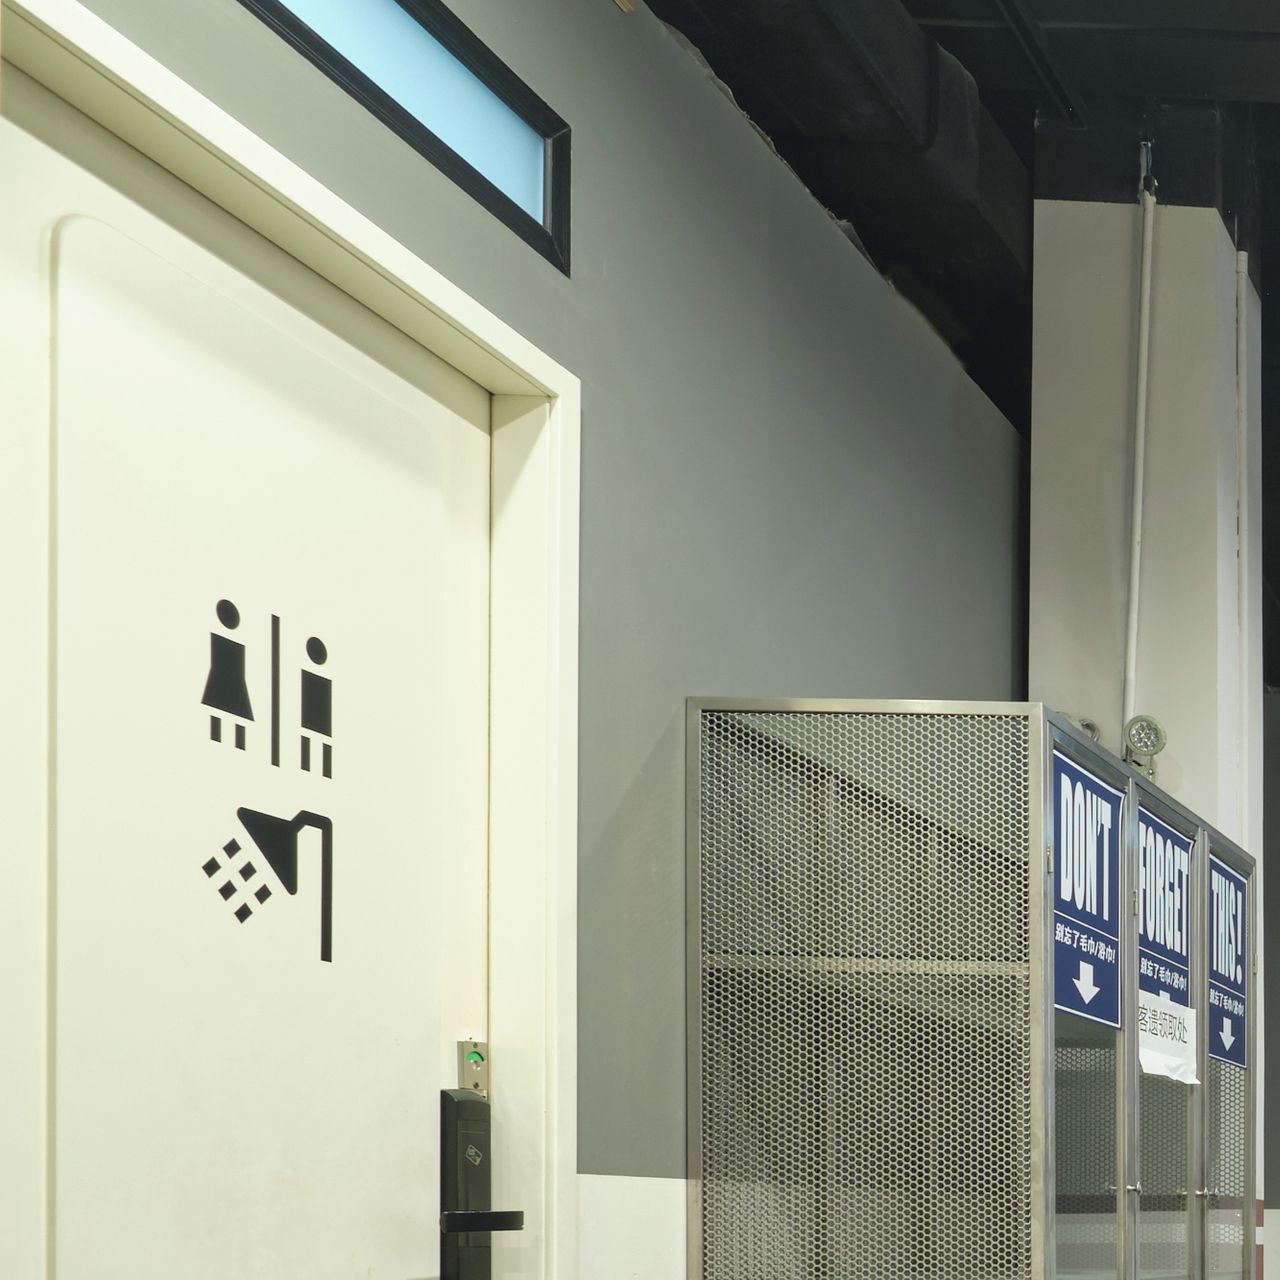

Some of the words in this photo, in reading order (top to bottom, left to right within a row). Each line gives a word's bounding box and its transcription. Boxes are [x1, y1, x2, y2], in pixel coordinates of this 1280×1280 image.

[1060, 772, 1112, 921] DON'T
[1139, 820, 1188, 956] FORGET
[1211, 868, 1243, 985] THIS!
